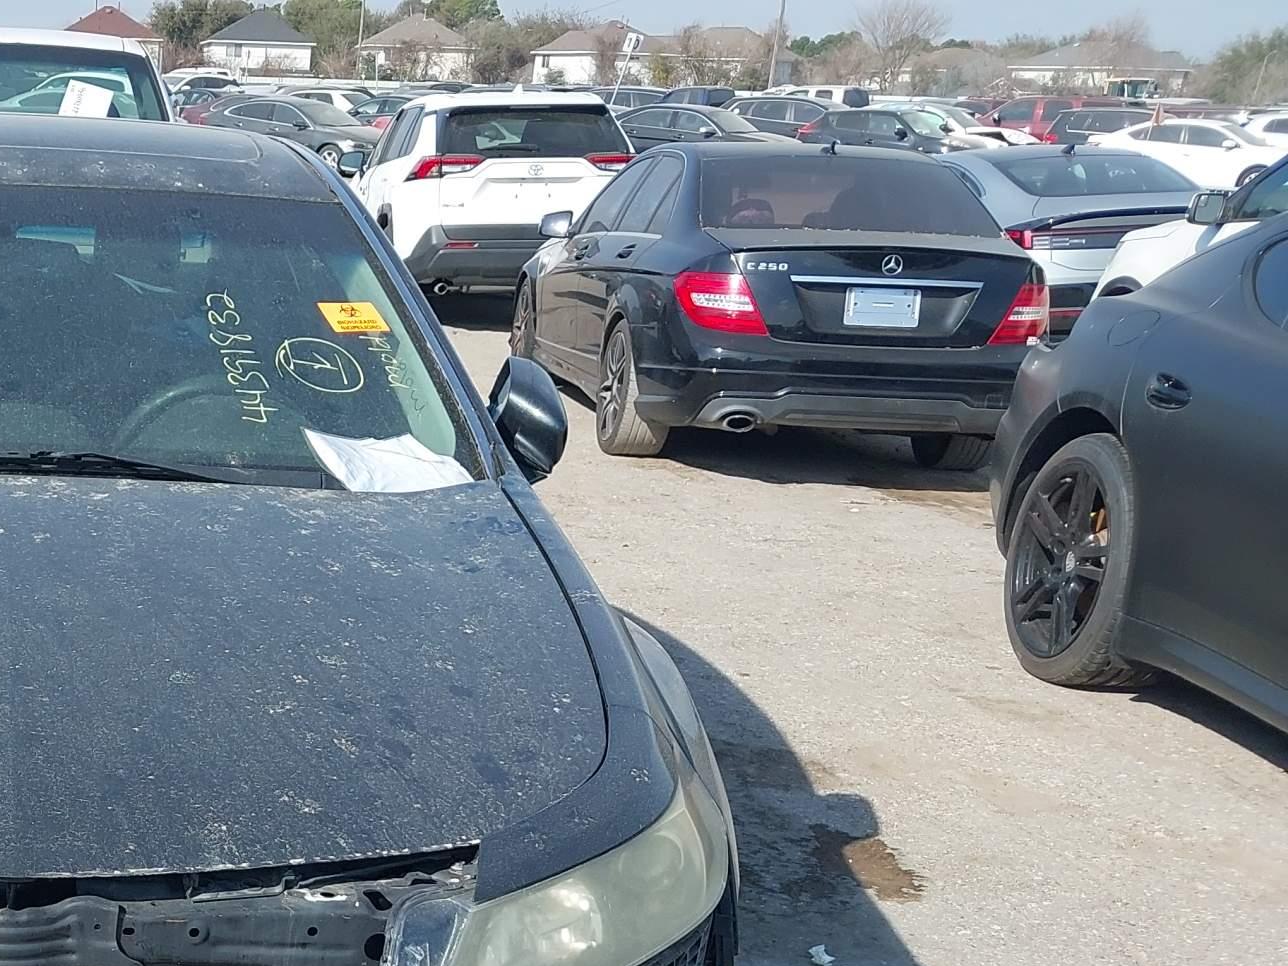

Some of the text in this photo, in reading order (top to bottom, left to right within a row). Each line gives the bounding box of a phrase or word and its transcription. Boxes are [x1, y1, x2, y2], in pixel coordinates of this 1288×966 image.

[746, 261, 789, 271] C 250
[205, 287, 279, 424] 44391832
